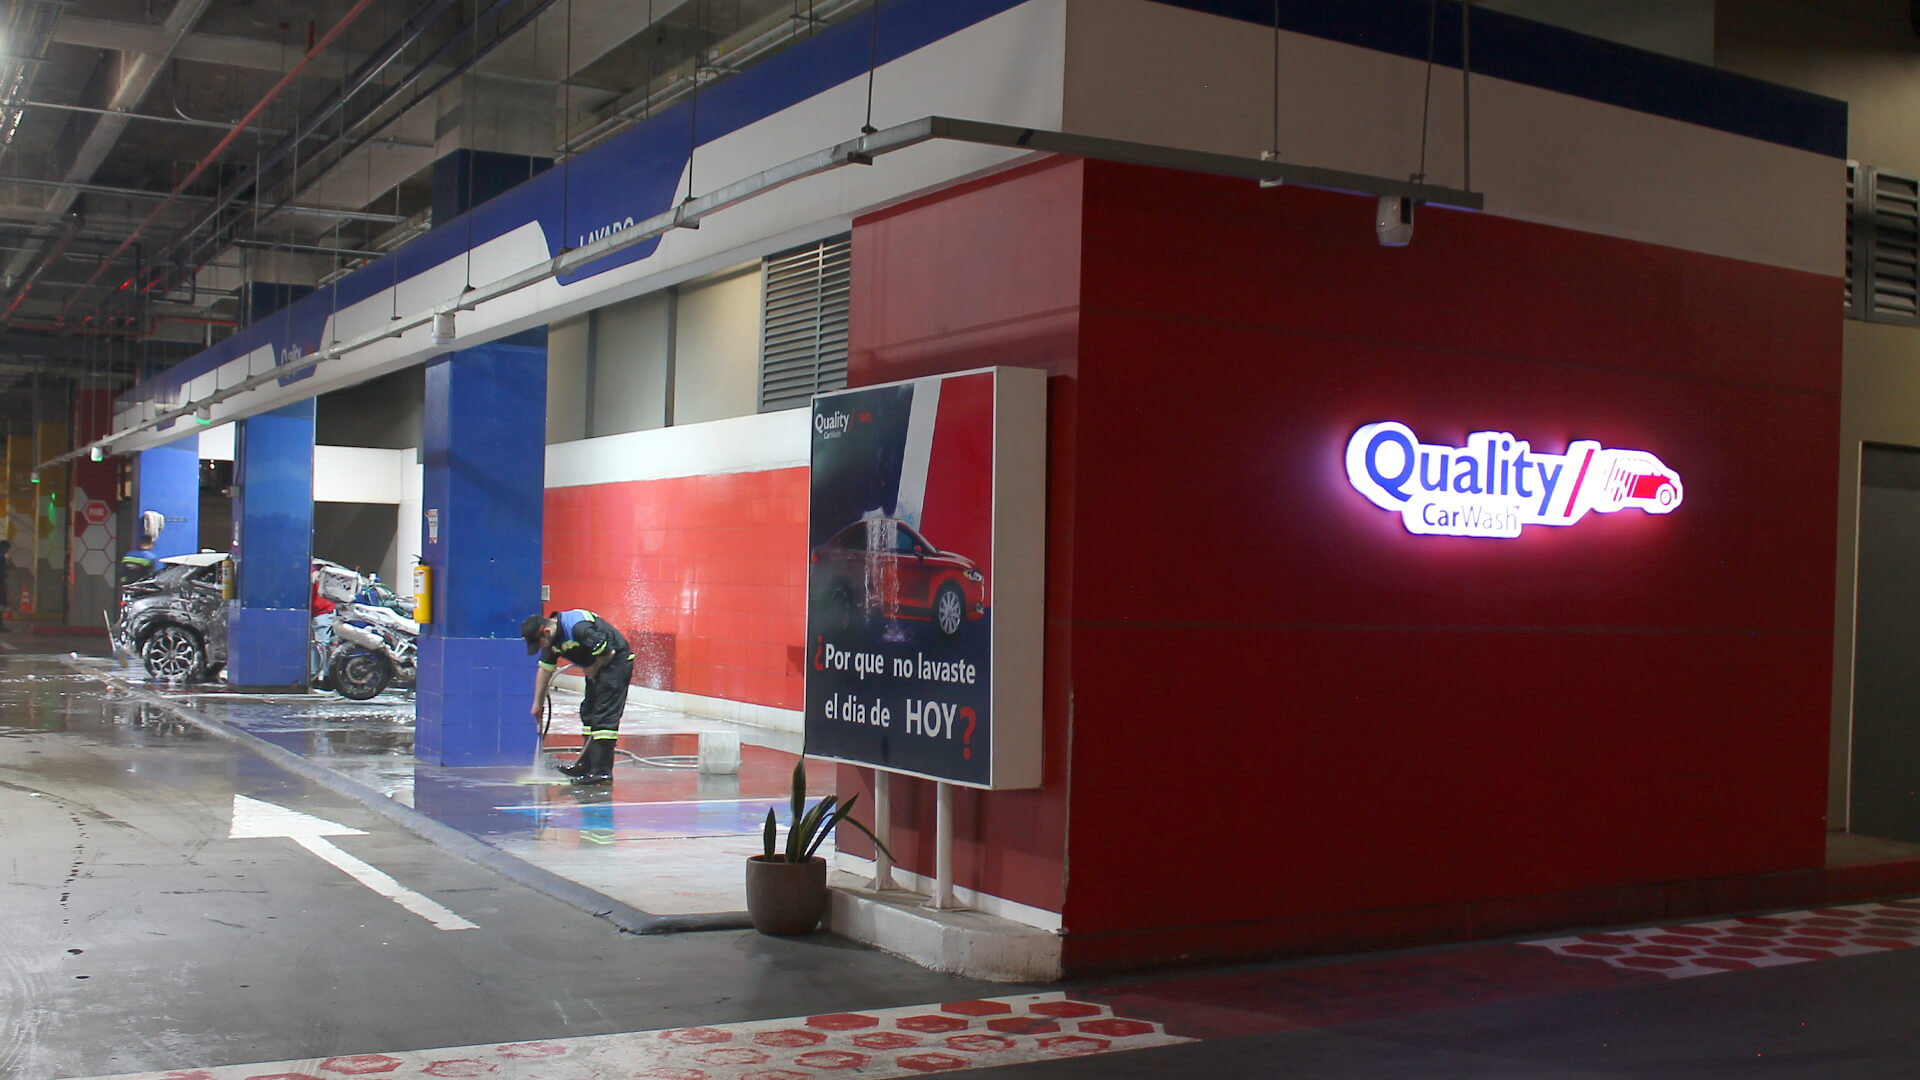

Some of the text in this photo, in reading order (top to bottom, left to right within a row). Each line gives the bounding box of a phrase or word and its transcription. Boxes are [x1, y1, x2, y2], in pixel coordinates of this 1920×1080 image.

[815, 411, 850, 434] Quality
[1365, 430, 1563, 517] Quality
[1422, 502, 1518, 530] CarWash
[855, 652, 884, 680] que
[893, 658, 913, 678] no
[918, 652, 976, 684] lavaste
[825, 693, 838, 719] el
[842, 695, 865, 724] dia
[870, 698, 890, 727] de
